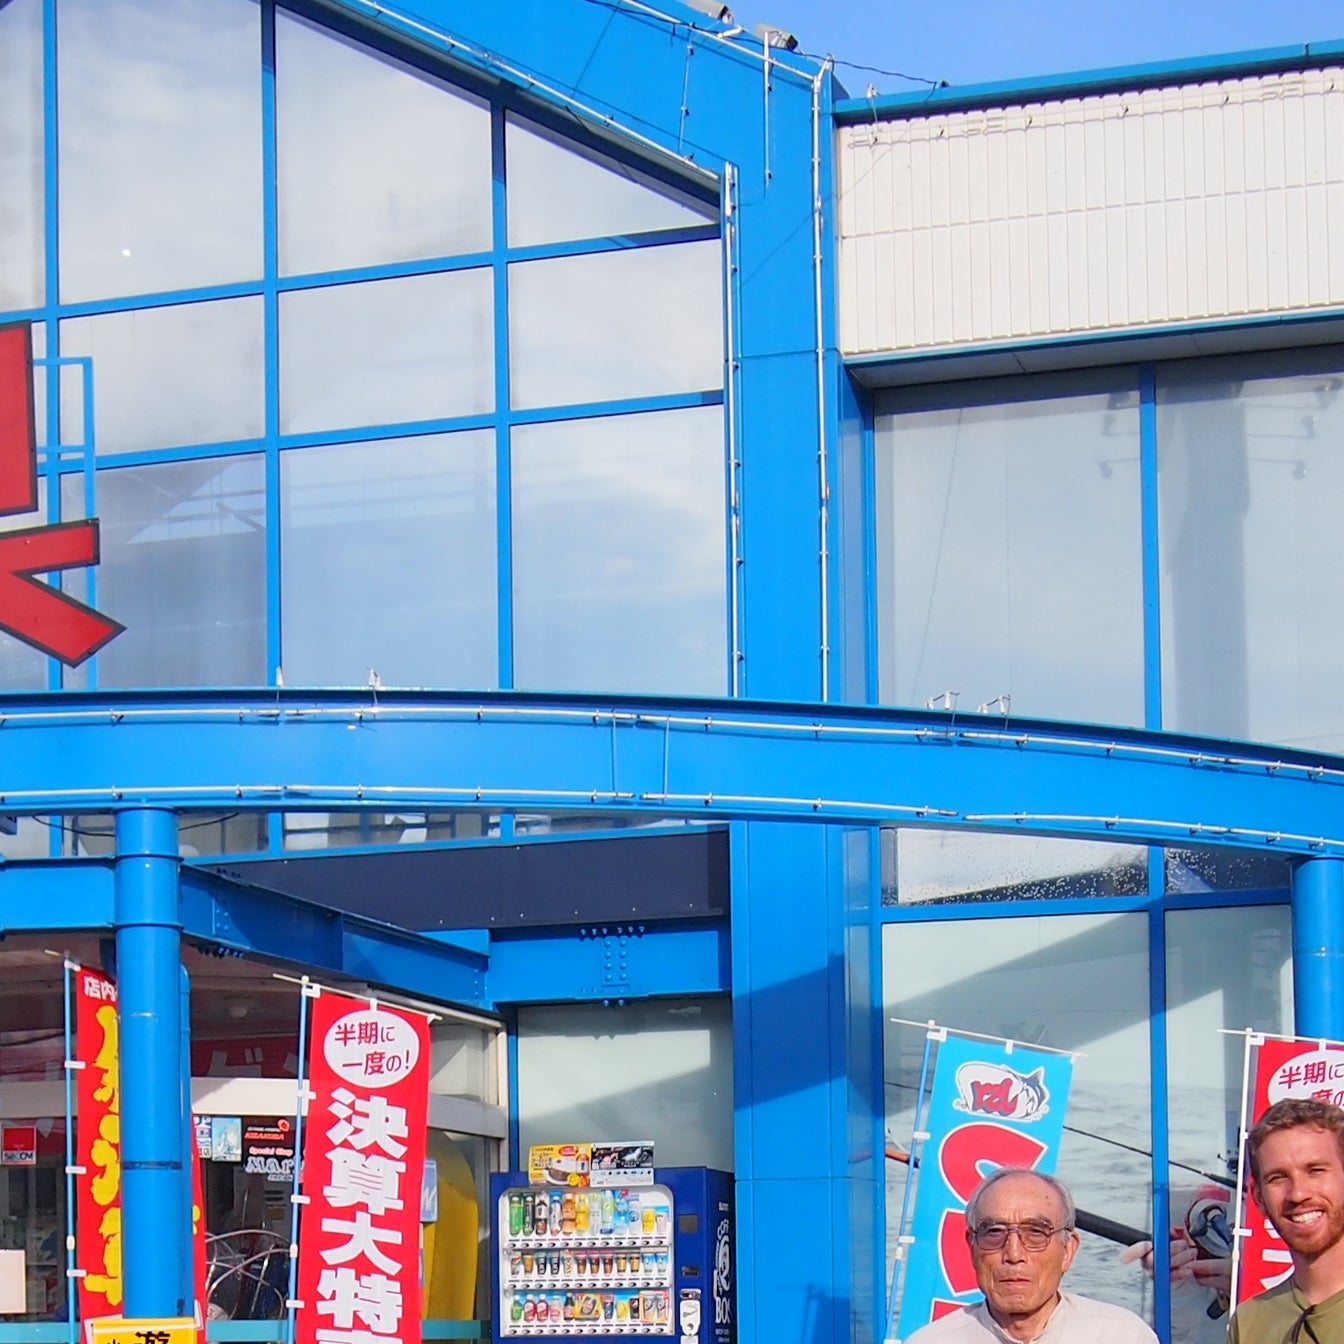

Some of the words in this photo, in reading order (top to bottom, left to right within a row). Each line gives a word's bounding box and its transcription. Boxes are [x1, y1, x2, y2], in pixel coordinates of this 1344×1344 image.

[334, 1021, 396, 1047] 半期に
[341, 1047, 411, 1076] 一度の!
